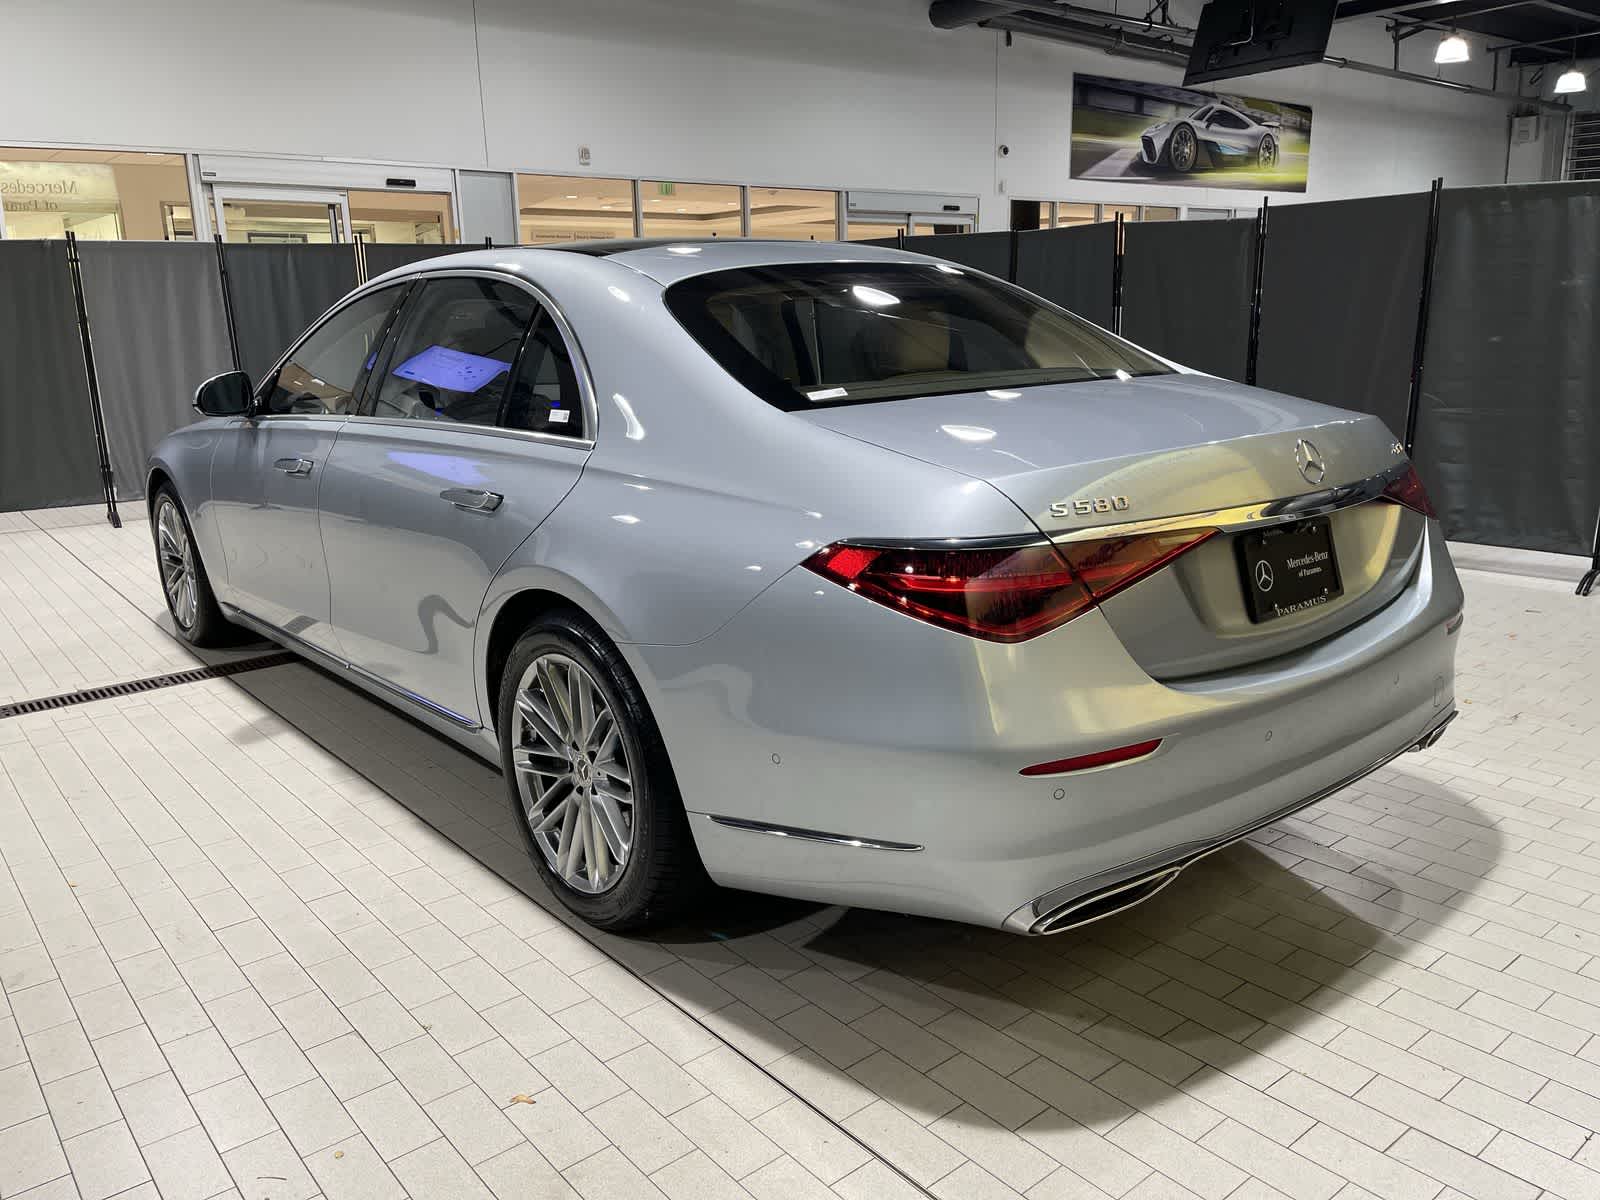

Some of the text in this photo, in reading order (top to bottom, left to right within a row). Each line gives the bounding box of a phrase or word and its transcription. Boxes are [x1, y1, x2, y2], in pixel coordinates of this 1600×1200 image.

[1050, 496, 1129, 517] S 580
[1286, 551, 1329, 569] Mercedes-Benz
[1277, 595, 1327, 616] PARAMUS
